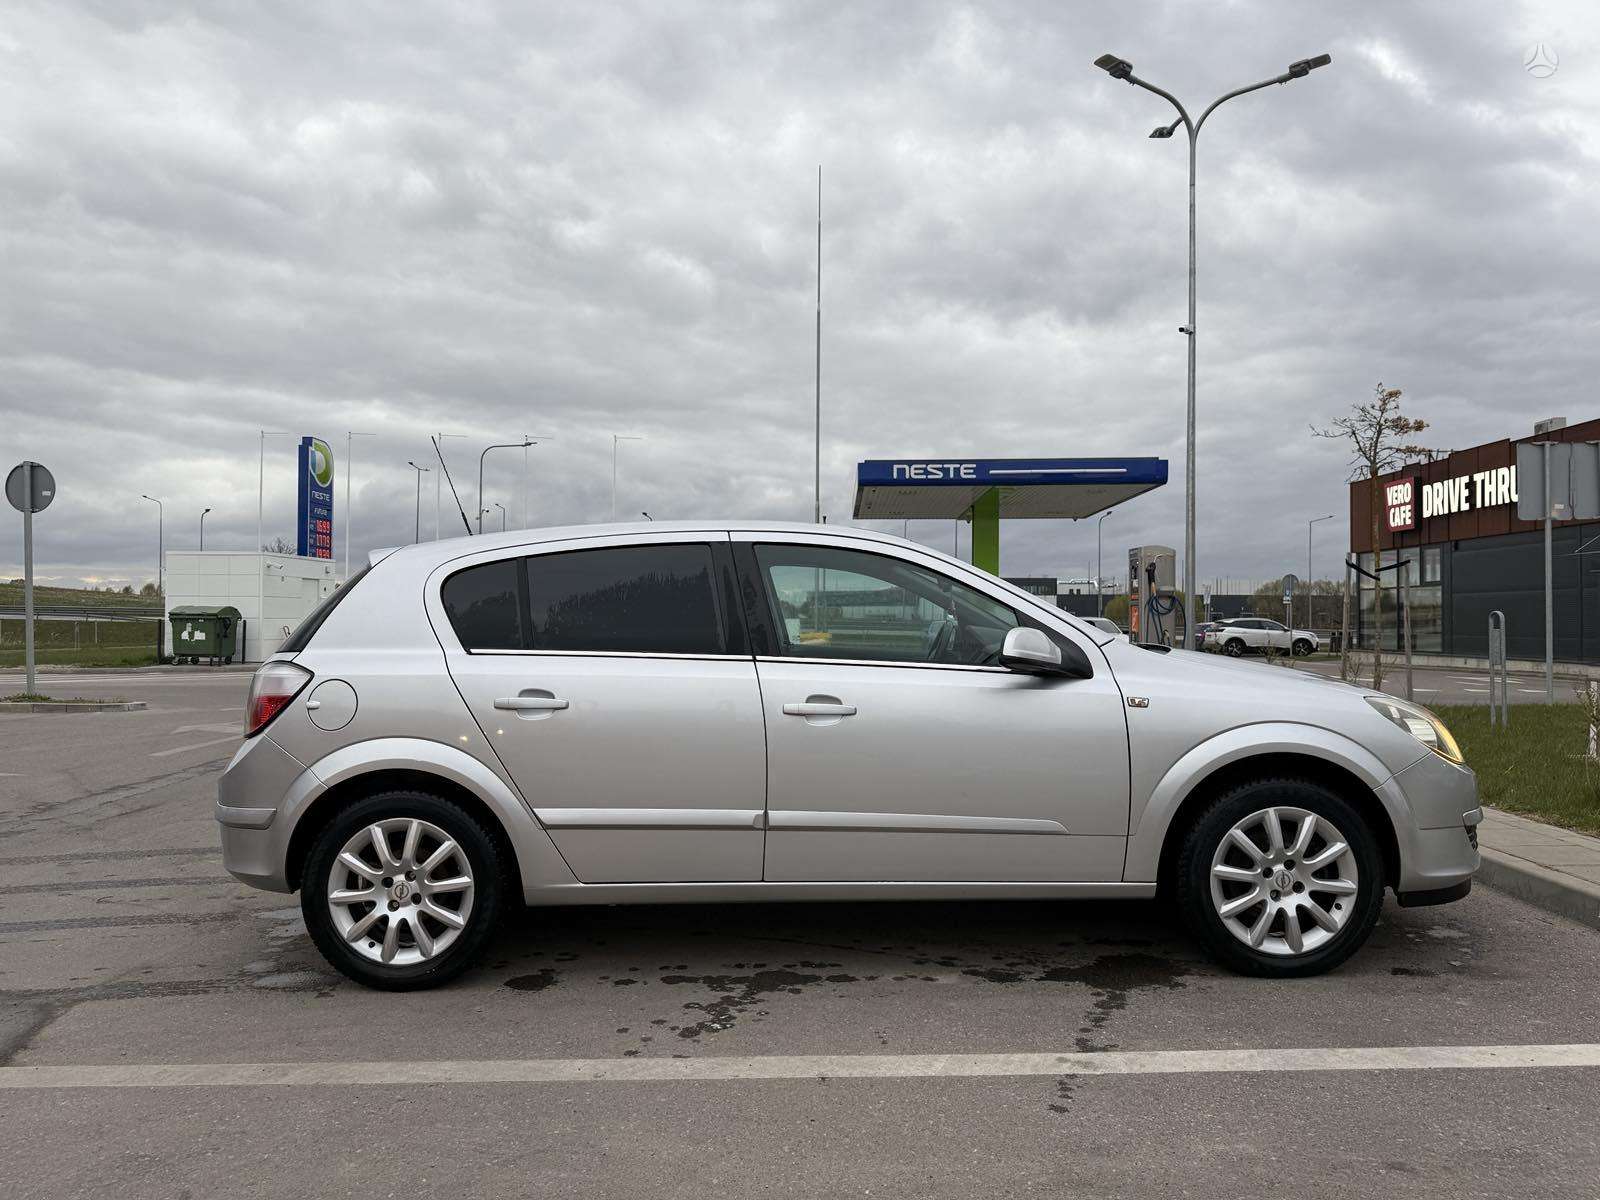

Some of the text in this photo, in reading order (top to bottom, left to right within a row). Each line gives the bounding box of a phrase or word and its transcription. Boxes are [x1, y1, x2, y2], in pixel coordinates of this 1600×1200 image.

[893, 464, 977, 479] NESTE
[311, 490, 331, 502] NESTE
[1387, 482, 1412, 506] VERO
[1422, 475, 1470, 518] DRIVE
[1389, 505, 1412, 527] CAFE
